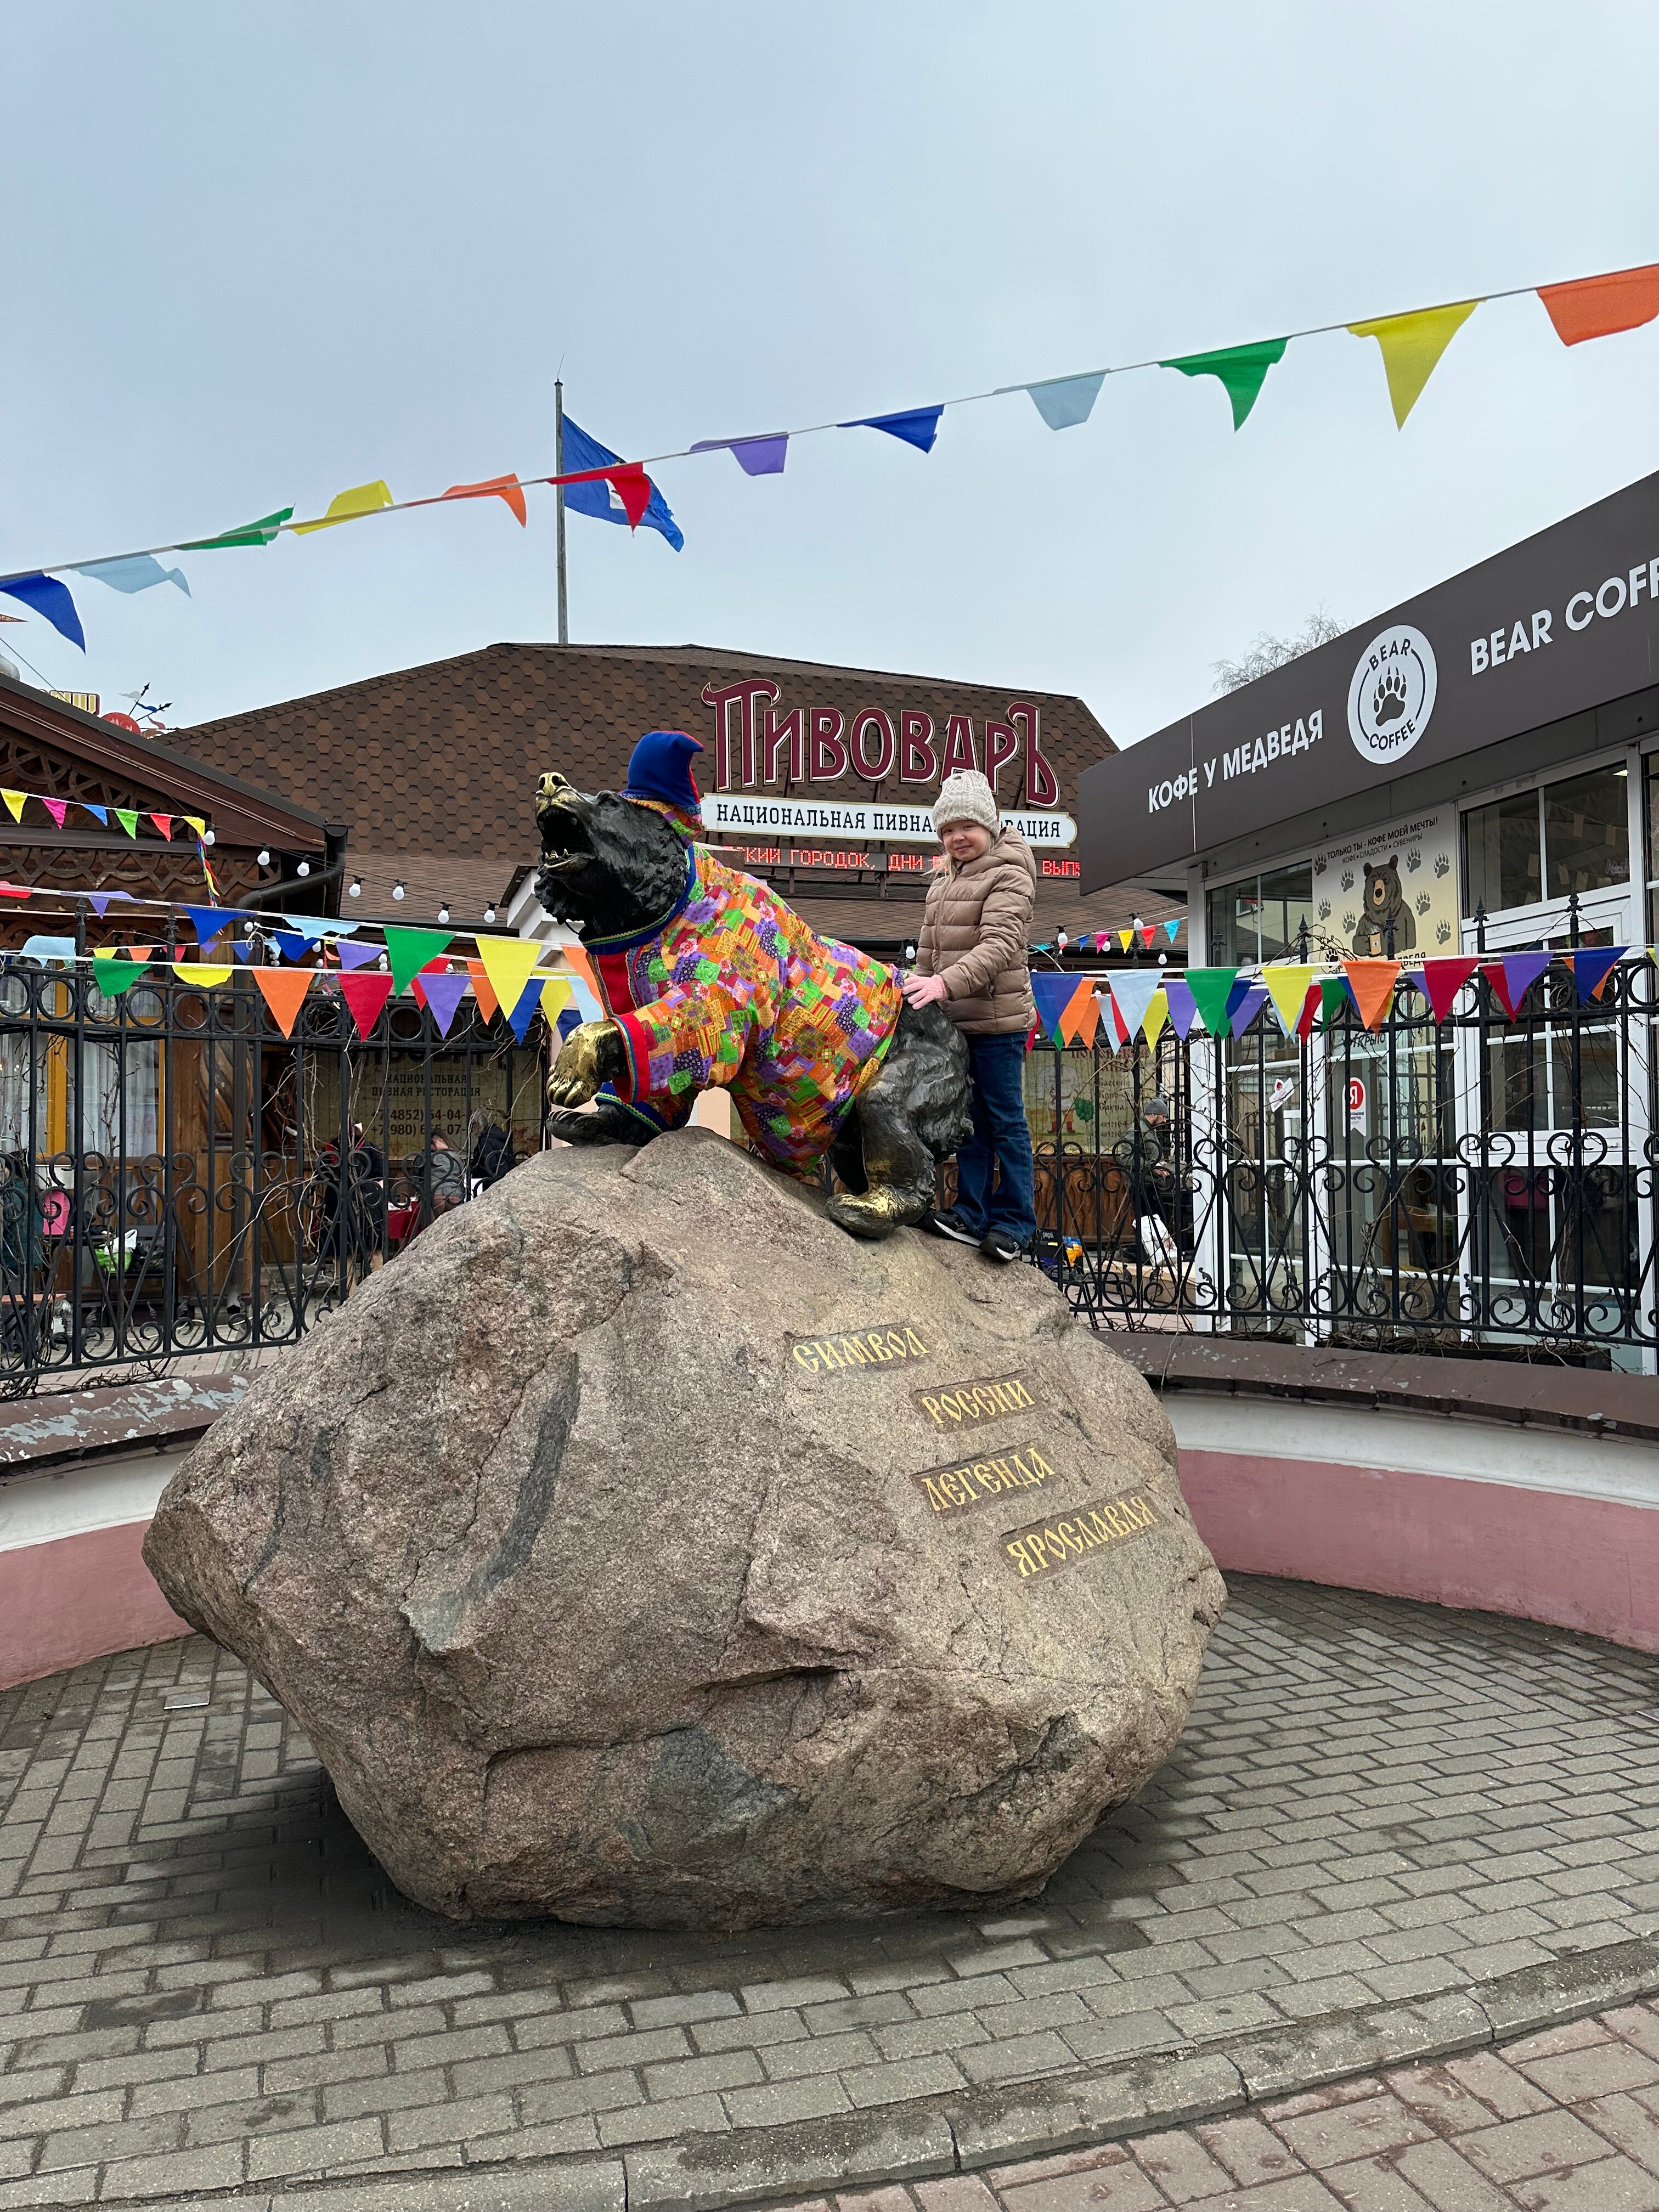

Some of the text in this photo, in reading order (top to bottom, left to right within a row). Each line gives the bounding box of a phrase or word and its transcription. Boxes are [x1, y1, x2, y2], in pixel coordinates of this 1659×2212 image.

[1369, 639, 1410, 671] BEAR
[1471, 609, 1553, 675] BEAR
[1369, 719, 1415, 750] COFFEE
[1149, 709, 1323, 813] КОФЕ У МЕДВЕДЯ
[716, 804, 866, 830] НАЦИОНАЛЬНАЯ
[873, 813, 936, 832] ПИВНА
[1327, 845, 1352, 860] ТОЛЬКО
[1353, 841, 1363, 853] ТЫ
[1368, 833, 1386, 848] КОФЕ
[1387, 825, 1408, 841] МОЕЙ
[1410, 816, 1438, 833] МЕЧТЫ!
[1393, 833, 1423, 848] СУВЕНИРЫ
[737, 847, 781, 864] КИЙ
[888, 854, 923, 871] ДНИ
[792, 1327, 930, 1373] СИМВОЛ
[921, 1379, 1035, 1425] РОССИИ
[921, 1447, 1055, 1511] ЛЕГЕНДА
[1006, 1496, 1159, 1578] ЯРОСЛАВЛЯ
